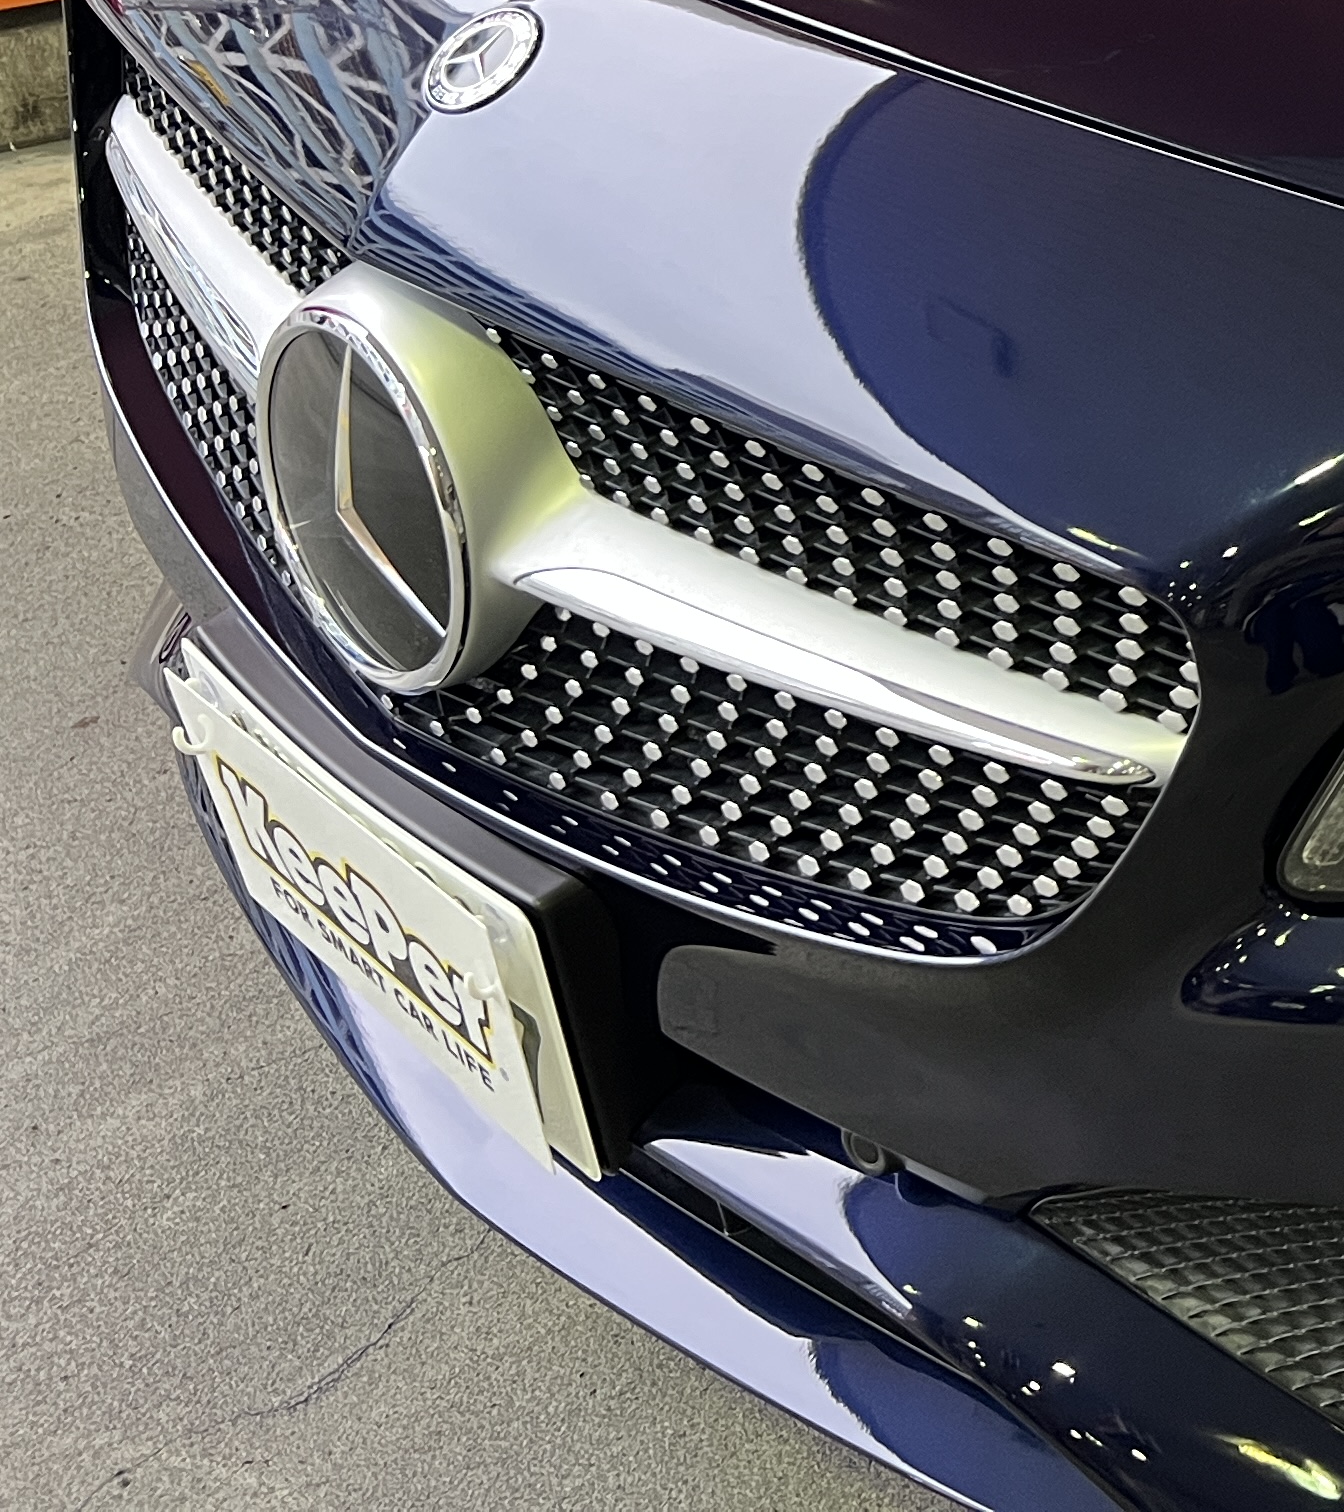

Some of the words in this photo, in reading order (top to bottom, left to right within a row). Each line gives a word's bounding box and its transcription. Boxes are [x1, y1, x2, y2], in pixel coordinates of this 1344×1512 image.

[270, 876, 315, 929] FOR
[317, 920, 388, 994] SMART
[393, 988, 440, 1043] CAR
[441, 1028, 496, 1093] LIFE
